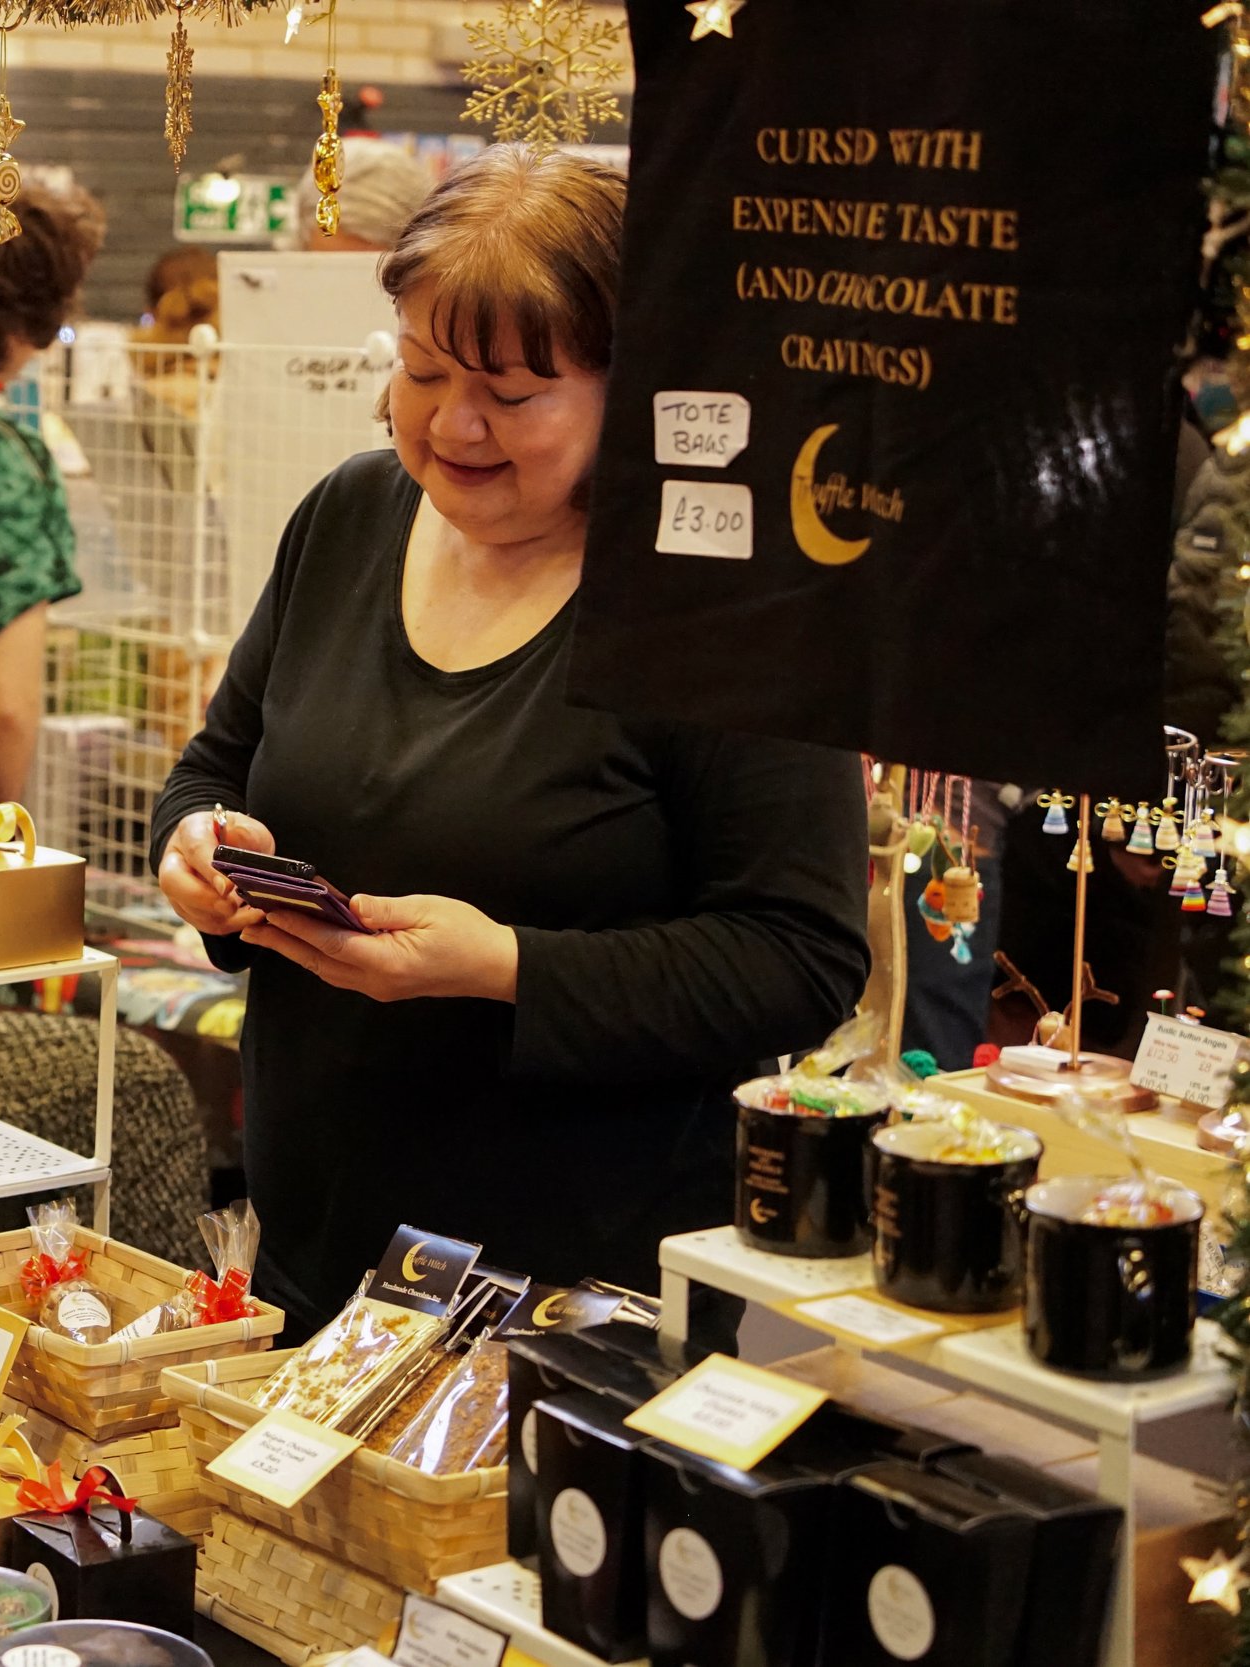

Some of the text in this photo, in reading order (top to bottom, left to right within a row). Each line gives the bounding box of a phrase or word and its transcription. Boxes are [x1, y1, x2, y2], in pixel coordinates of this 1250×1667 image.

[888, 129, 982, 171] WITH
[896, 203, 1019, 250] TASTE
[736, 262, 1019, 325] (AND CHOCOLATE
[781, 334, 932, 391] CRAVINGS)
[661, 402, 732, 424] TOTE
[672, 431, 729, 455] BAGS
[672, 496, 744, 533] £3.00
[1178, 1030, 1202, 1042] Button
[1202, 1037, 1228, 1049] Angels
[428, 1257, 447, 1272] Witch
[381, 1281, 408, 1294] Handmade
[407, 1287, 432, 1299] Chocolate
